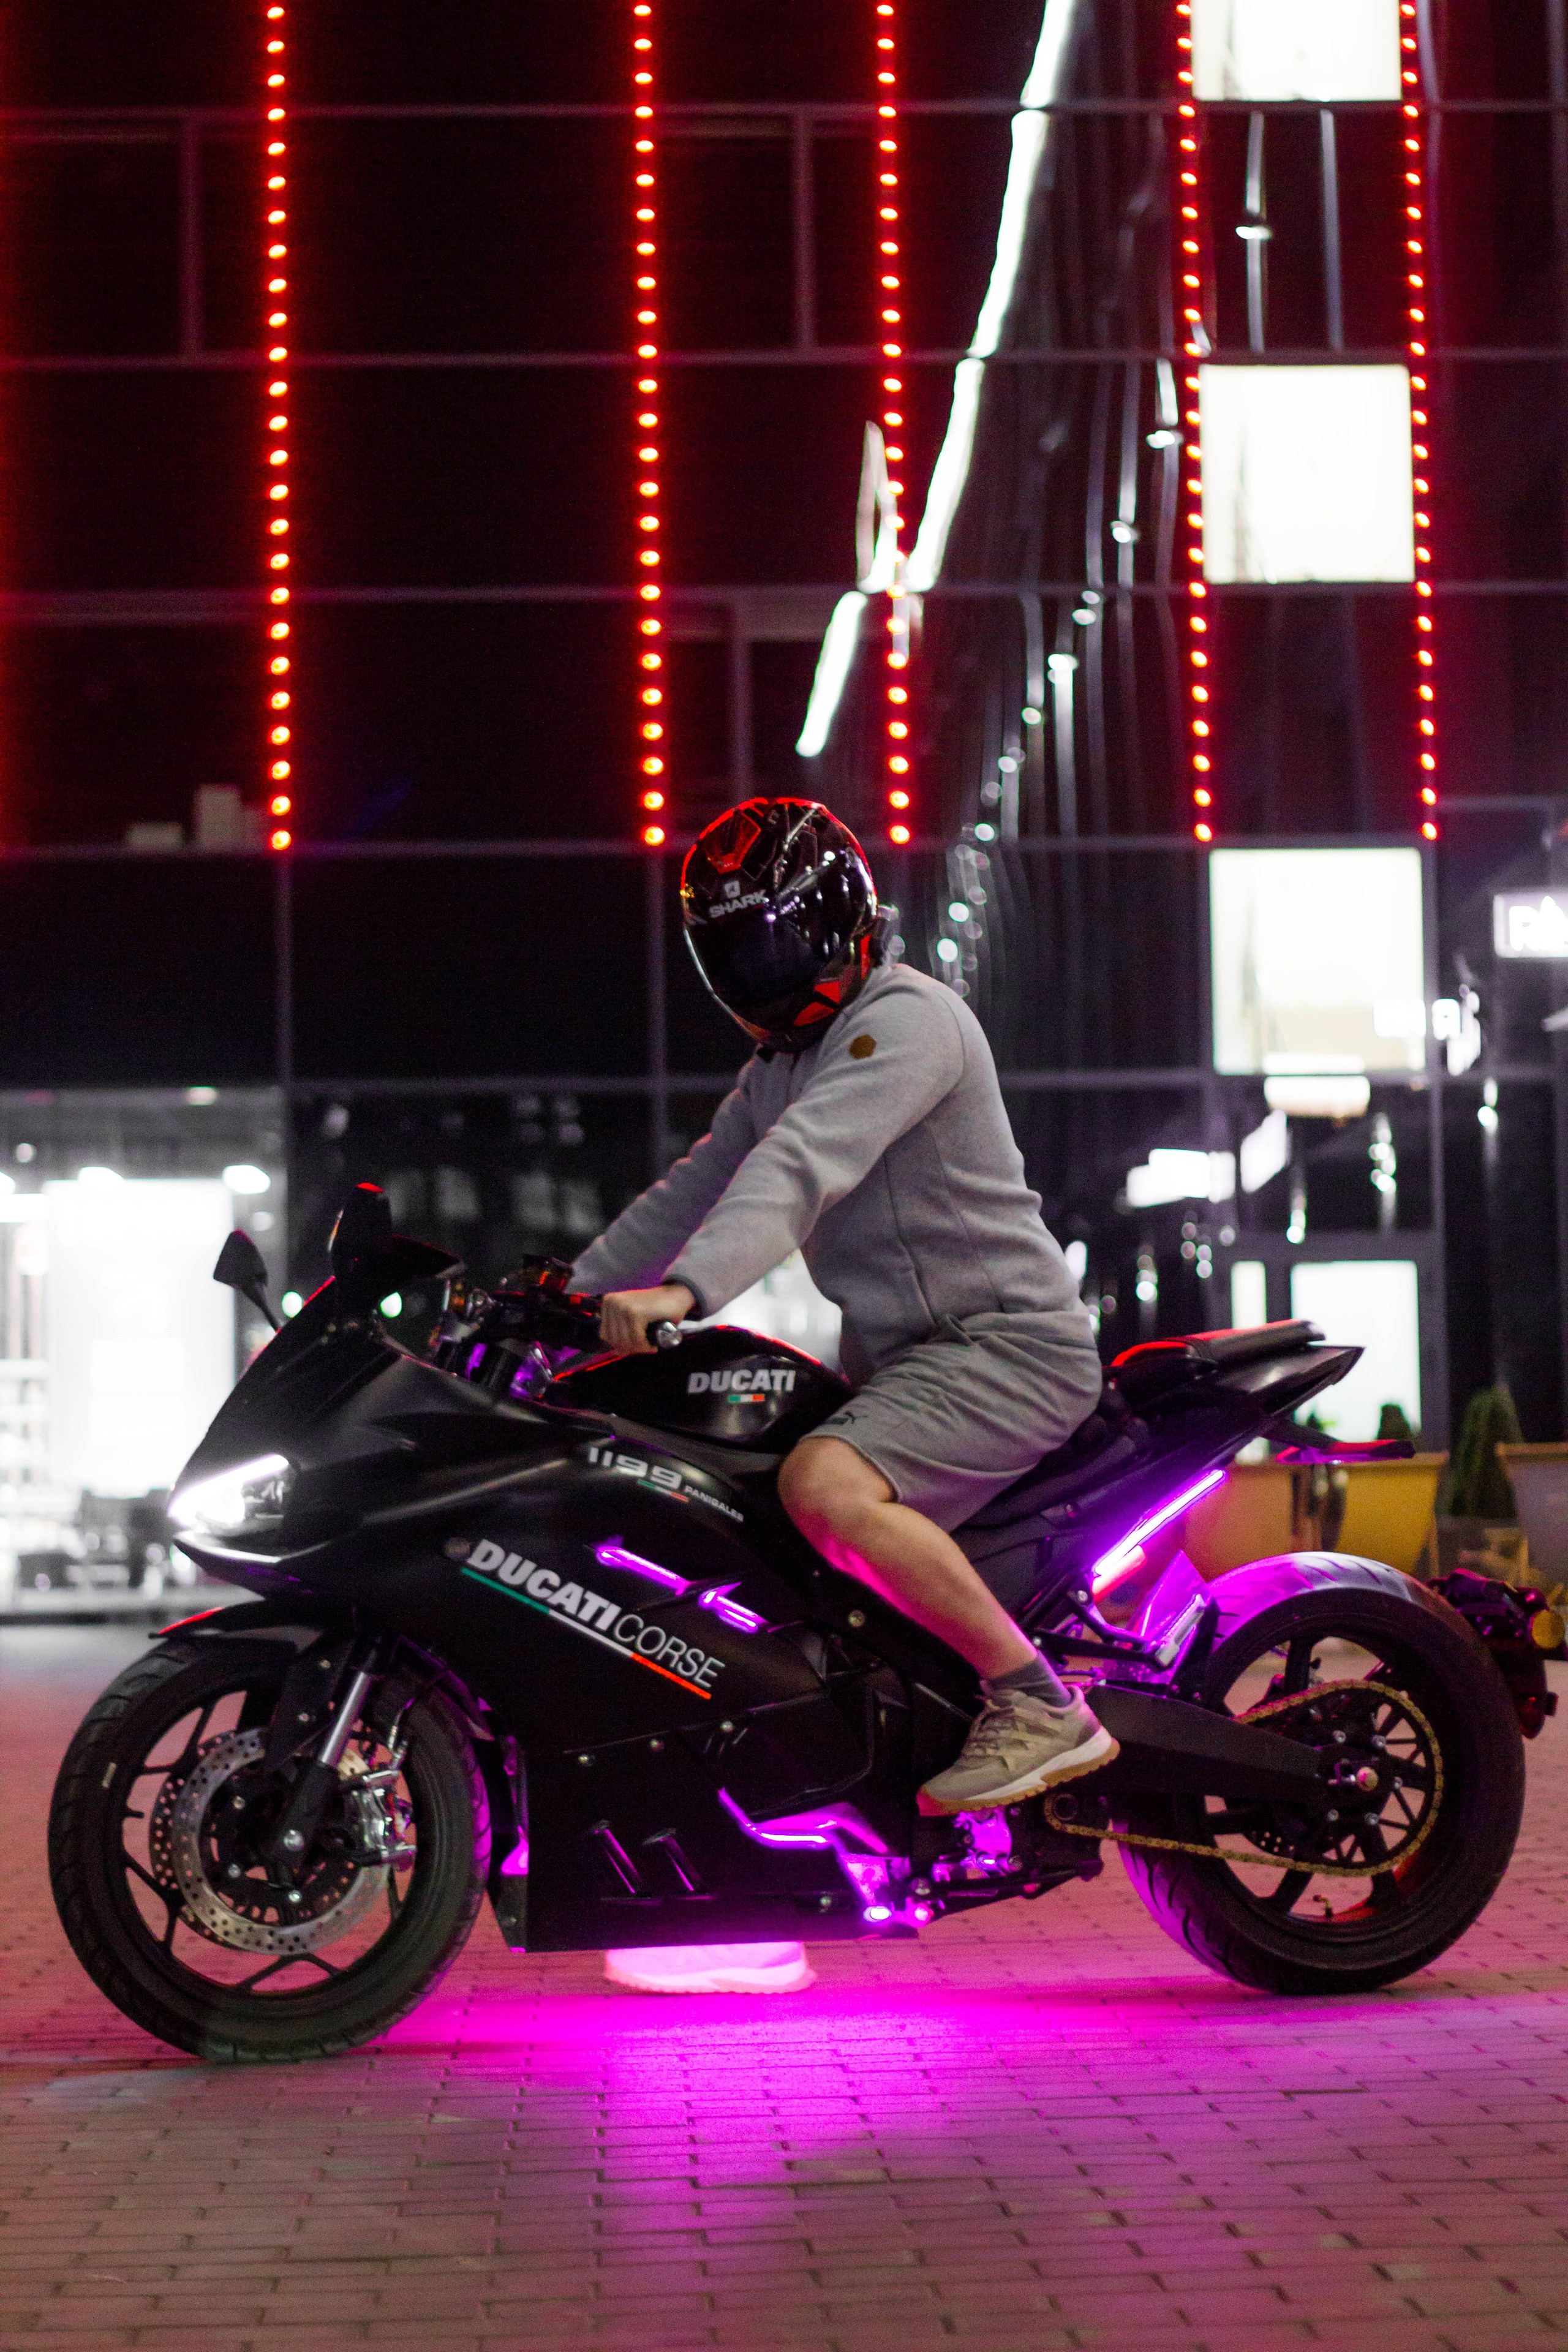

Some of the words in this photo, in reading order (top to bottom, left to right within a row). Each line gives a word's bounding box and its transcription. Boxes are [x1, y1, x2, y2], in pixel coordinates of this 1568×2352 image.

[709, 889, 769, 918] SHARK
[687, 1369, 796, 1393] DUCATI
[588, 1447, 682, 1490] 1199
[467, 1539, 622, 1631] DUCATI
[614, 1613, 725, 1688] CORSE
